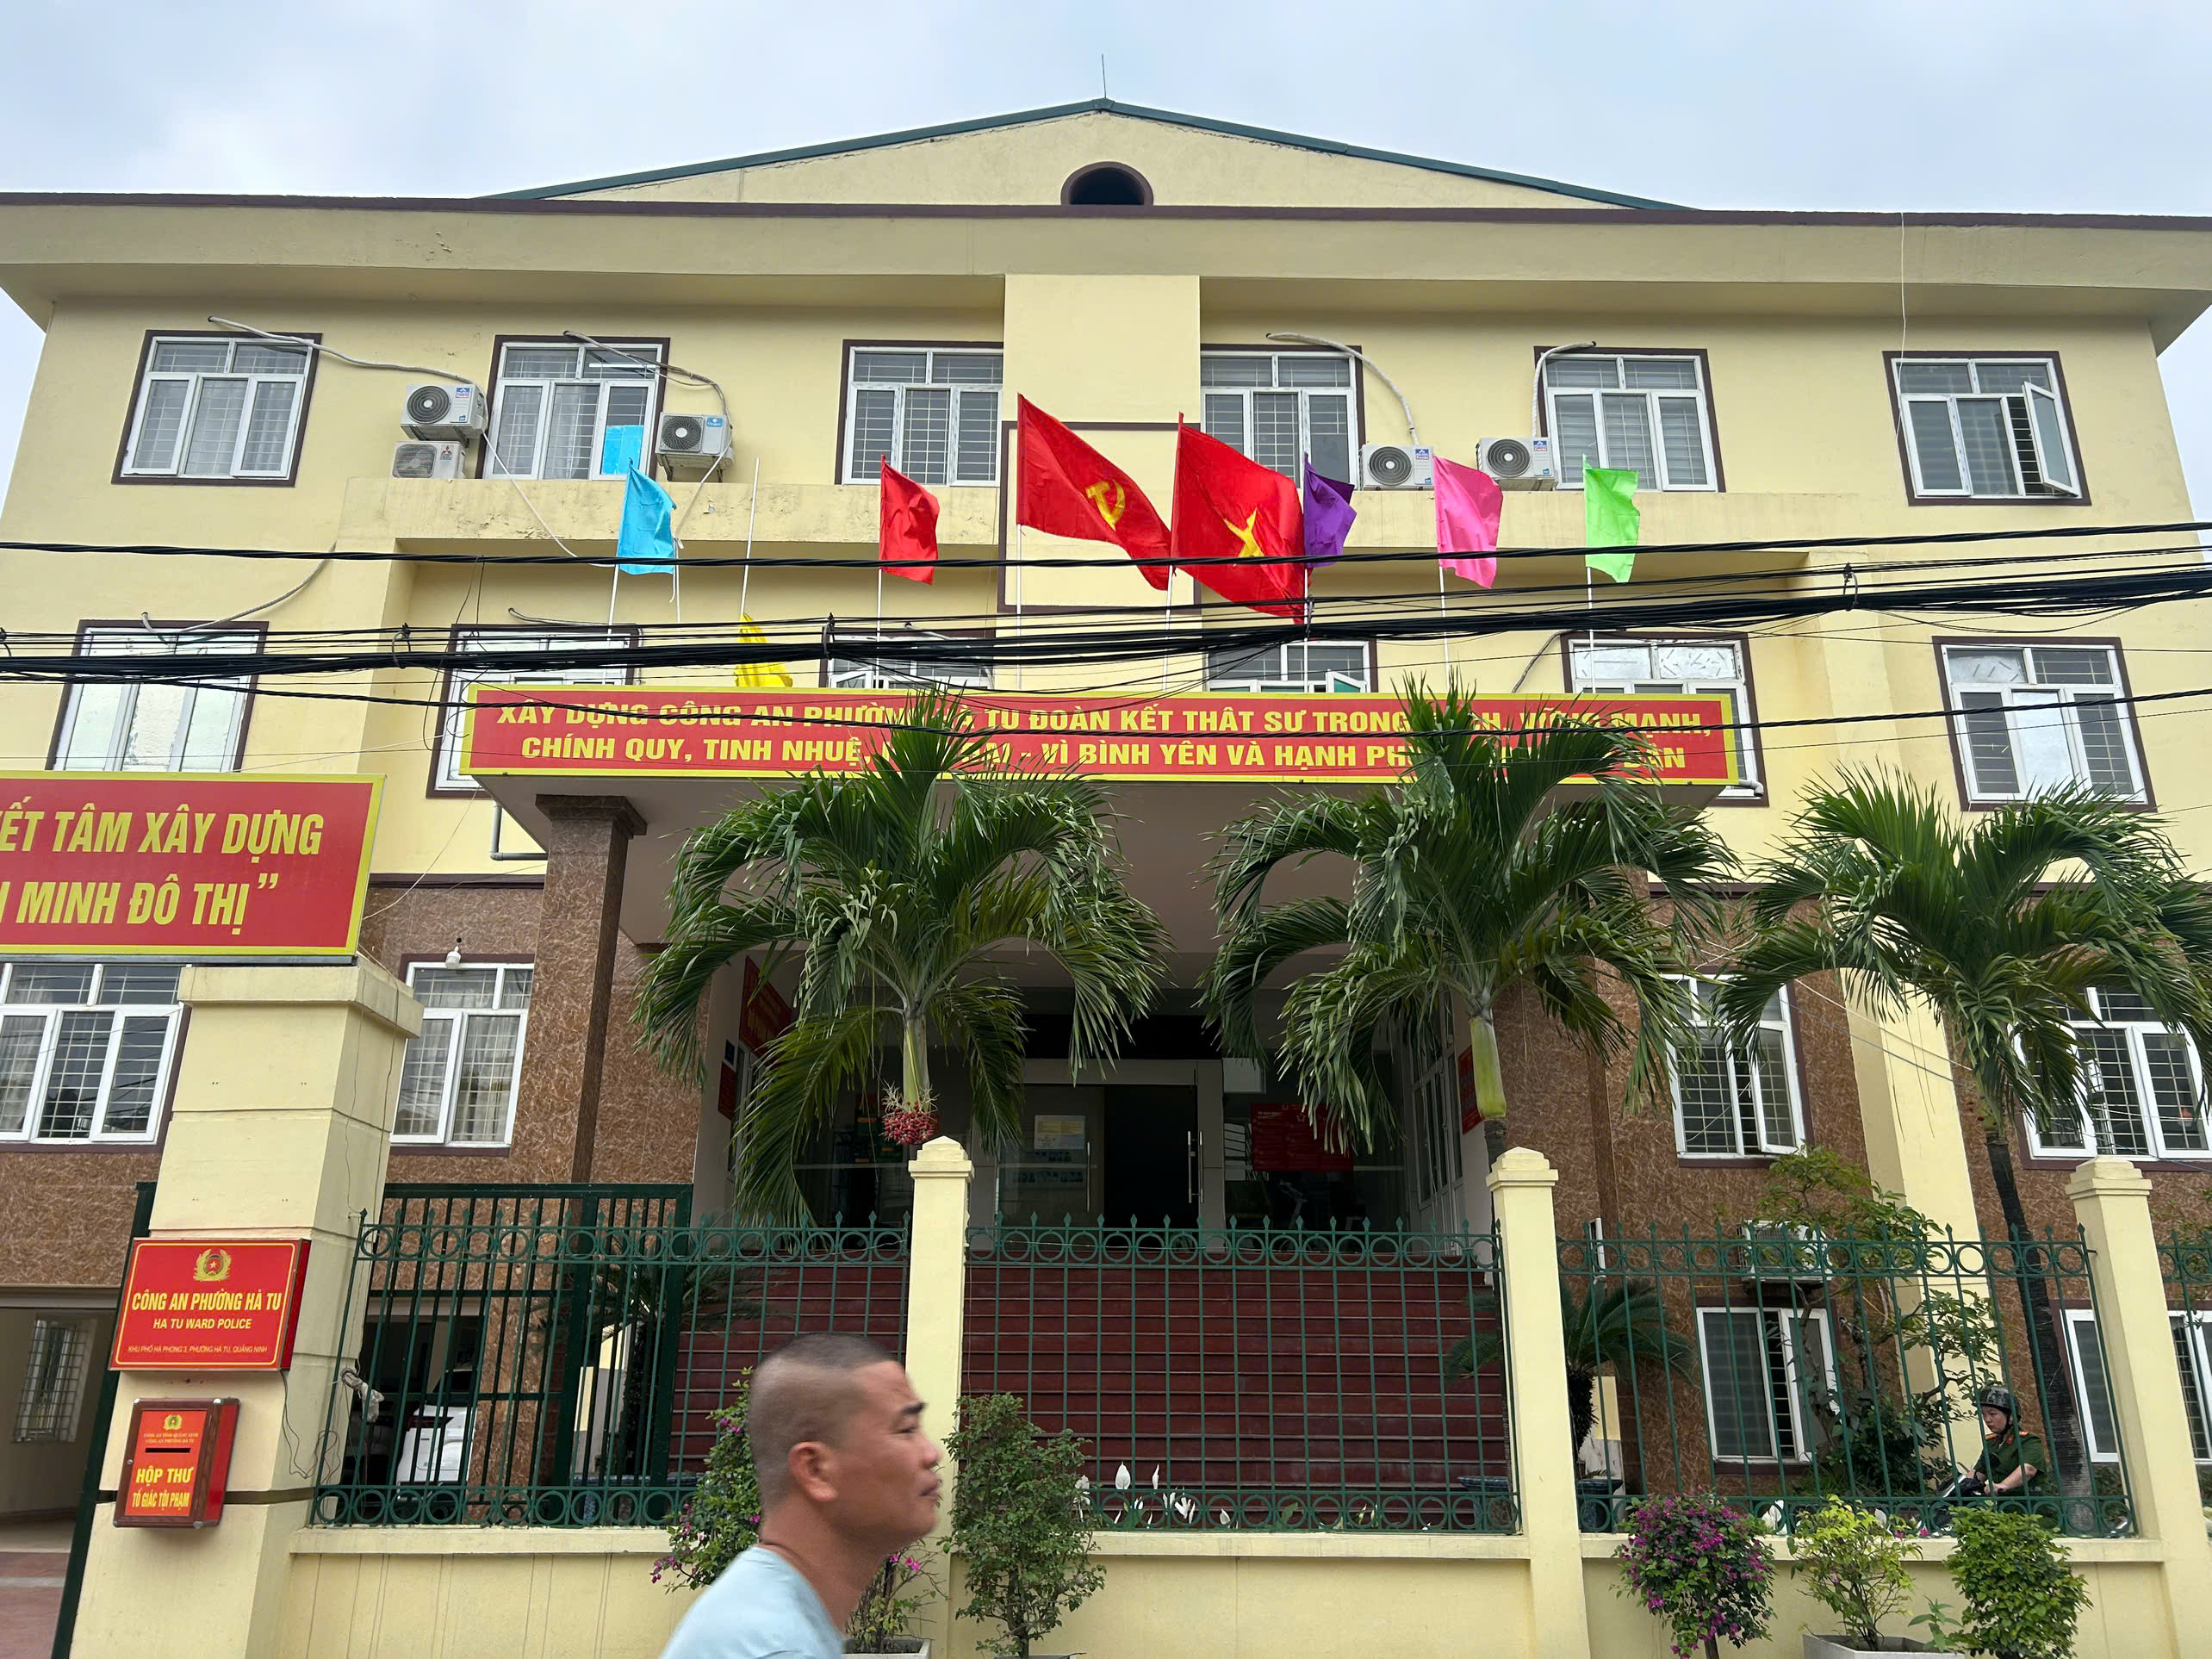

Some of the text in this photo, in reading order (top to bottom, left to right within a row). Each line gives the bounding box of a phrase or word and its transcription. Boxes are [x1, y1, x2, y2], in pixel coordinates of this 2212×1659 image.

[497, 699, 556, 724] XÂY
[565, 702, 648, 729] DỰNG
[659, 700, 742, 725] CÔNG
[751, 705, 793, 726] AN
[1029, 705, 1109, 730] ĐOÀN
[1121, 703, 1173, 730] KẾT
[1313, 711, 1411, 733] TRONG
[521, 733, 615, 759] CHÍNH
[625, 738, 693, 762] QUY,
[704, 739, 772, 761] TINH
[1041, 739, 1068, 764] VÌ
[1078, 740, 1149, 765] BÌNH
[1159, 741, 1217, 765] YÊN
[1227, 741, 1265, 765] VÀ
[1275, 745, 1357, 770] HẠNH
[0, 796, 324, 863] ẾT TÂM XÂY DỰNG
[16, 881, 121, 924] MINH
[127, 873, 180, 925] ĐÔ
[132, 1289, 282, 1310] CÔNG AN PHƯỜNG HÀ TU
[153, 1319, 252, 1329] HA TU WARD POLICE
[136, 1465, 194, 1487] HỘP THƯ
[132, 1488, 190, 1510] TỐ GIÁC TỘI PHẠM
